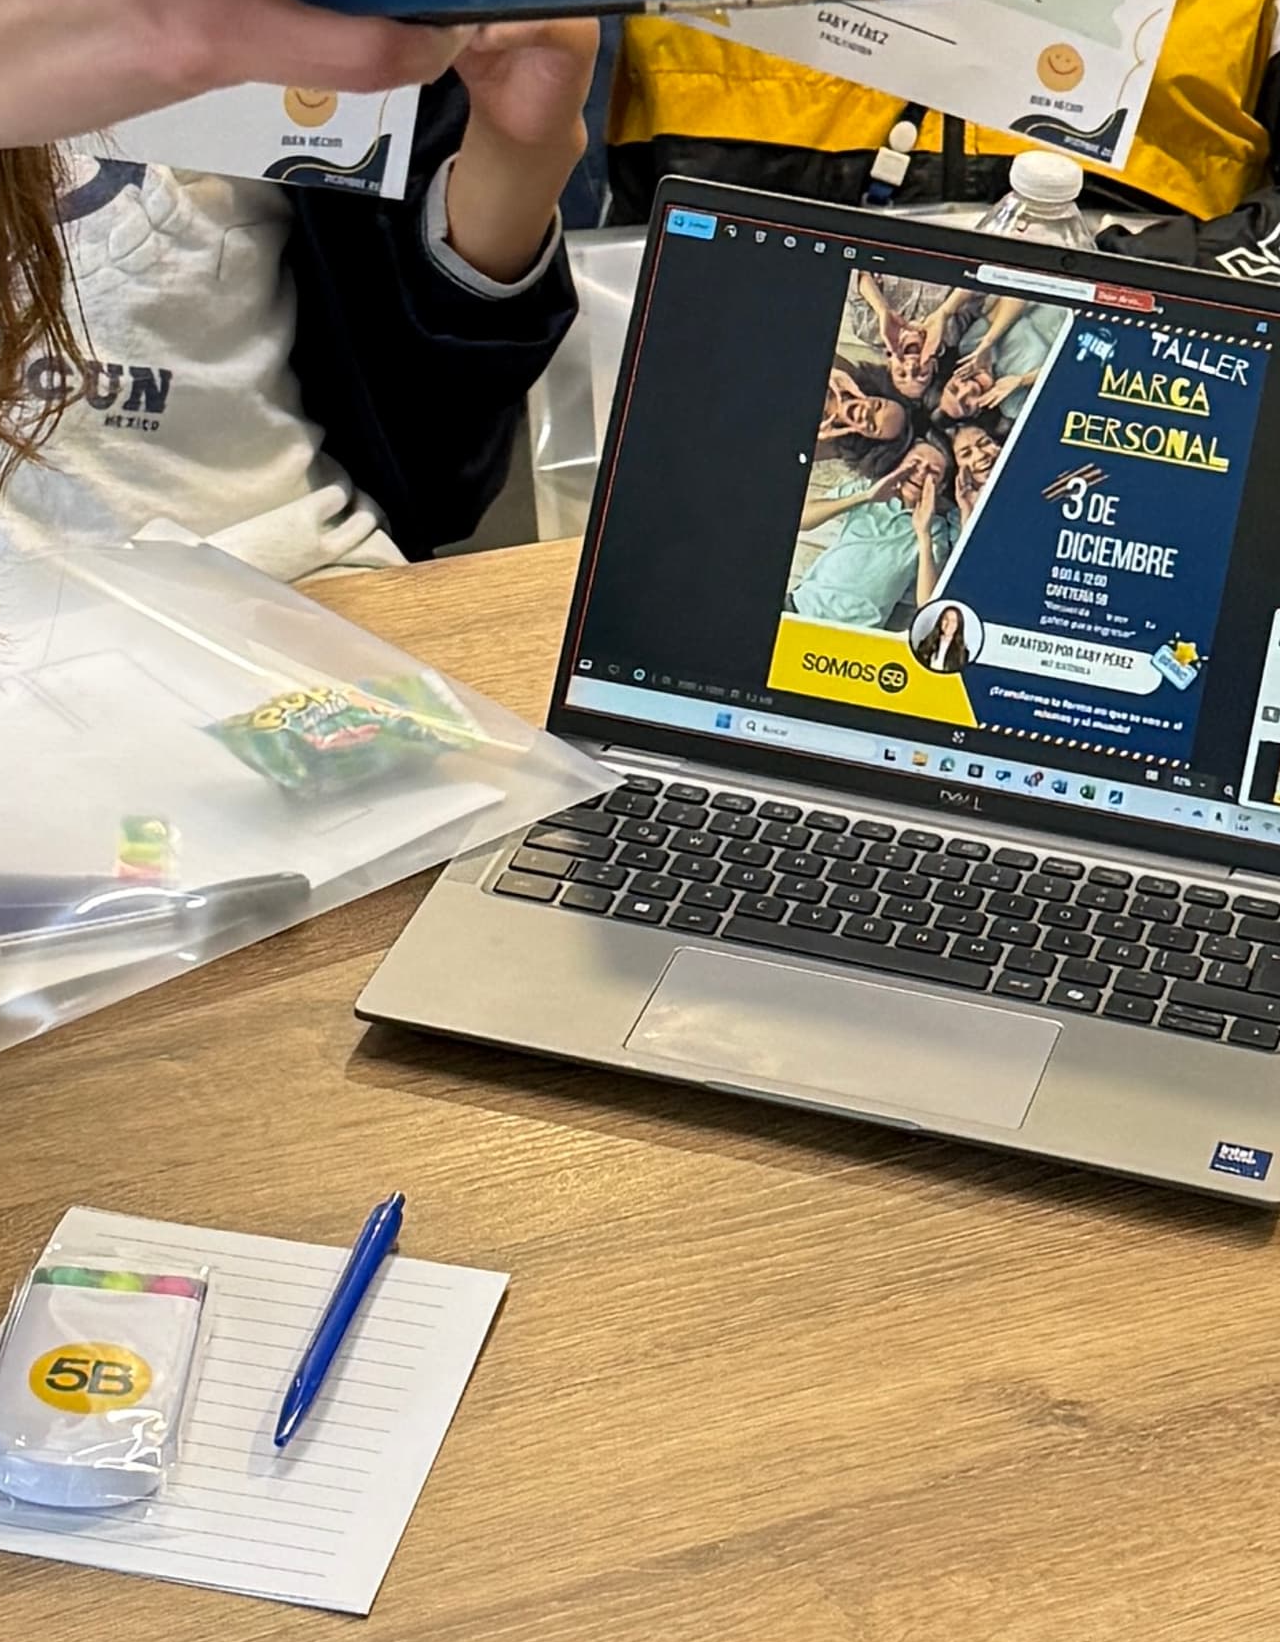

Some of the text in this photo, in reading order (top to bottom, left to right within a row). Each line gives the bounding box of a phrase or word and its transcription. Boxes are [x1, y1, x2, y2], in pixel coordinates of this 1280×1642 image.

[1151, 331, 1250, 386] TALLER
[1100, 364, 1210, 411] MARCA
[1062, 410, 1229, 468] PERSONAL
[1062, 477, 1120, 526] 3 DE
[1056, 529, 1178, 578] DICIEMBRE
[802, 652, 907, 690] SOMOS 5B
[43, 1356, 136, 1398] 5B
